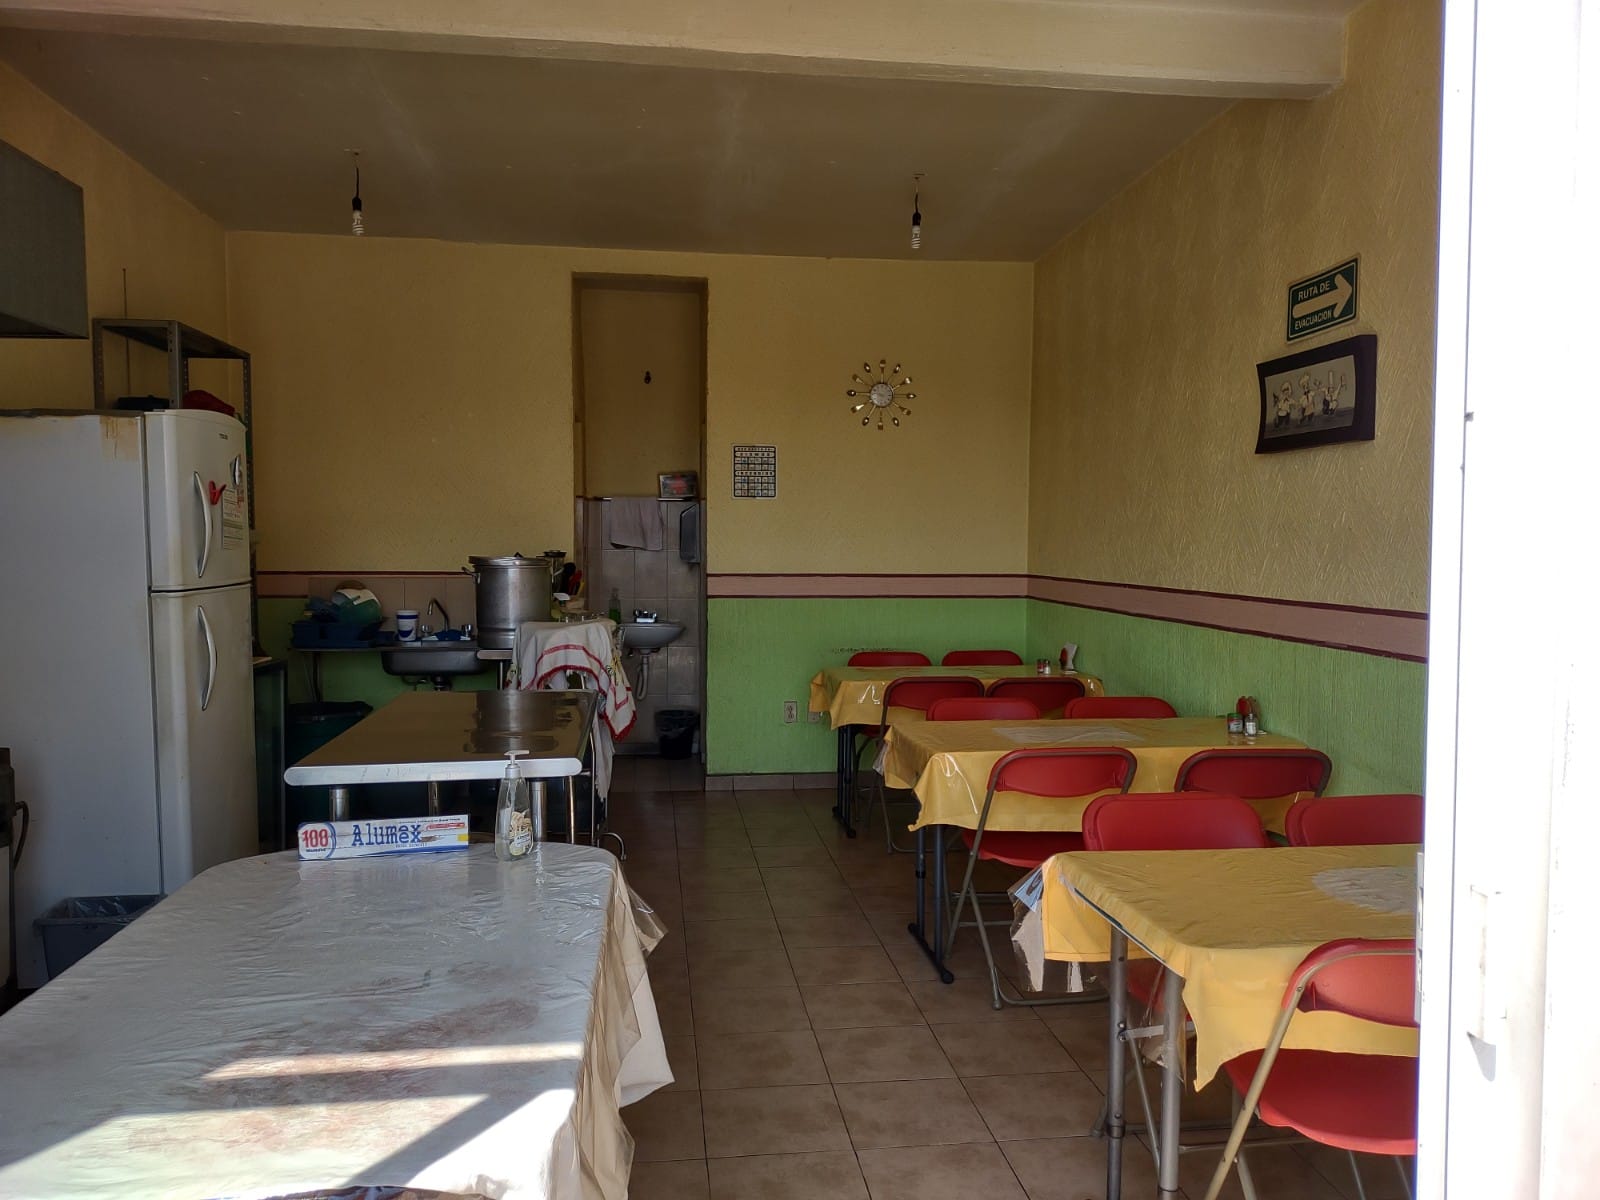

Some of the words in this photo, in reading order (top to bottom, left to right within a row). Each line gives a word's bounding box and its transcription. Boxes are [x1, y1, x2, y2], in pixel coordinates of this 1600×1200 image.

[1298, 285, 1318, 301] RUTA
[1320, 281, 1331, 293] DE
[352, 823, 422, 846] Alumex
